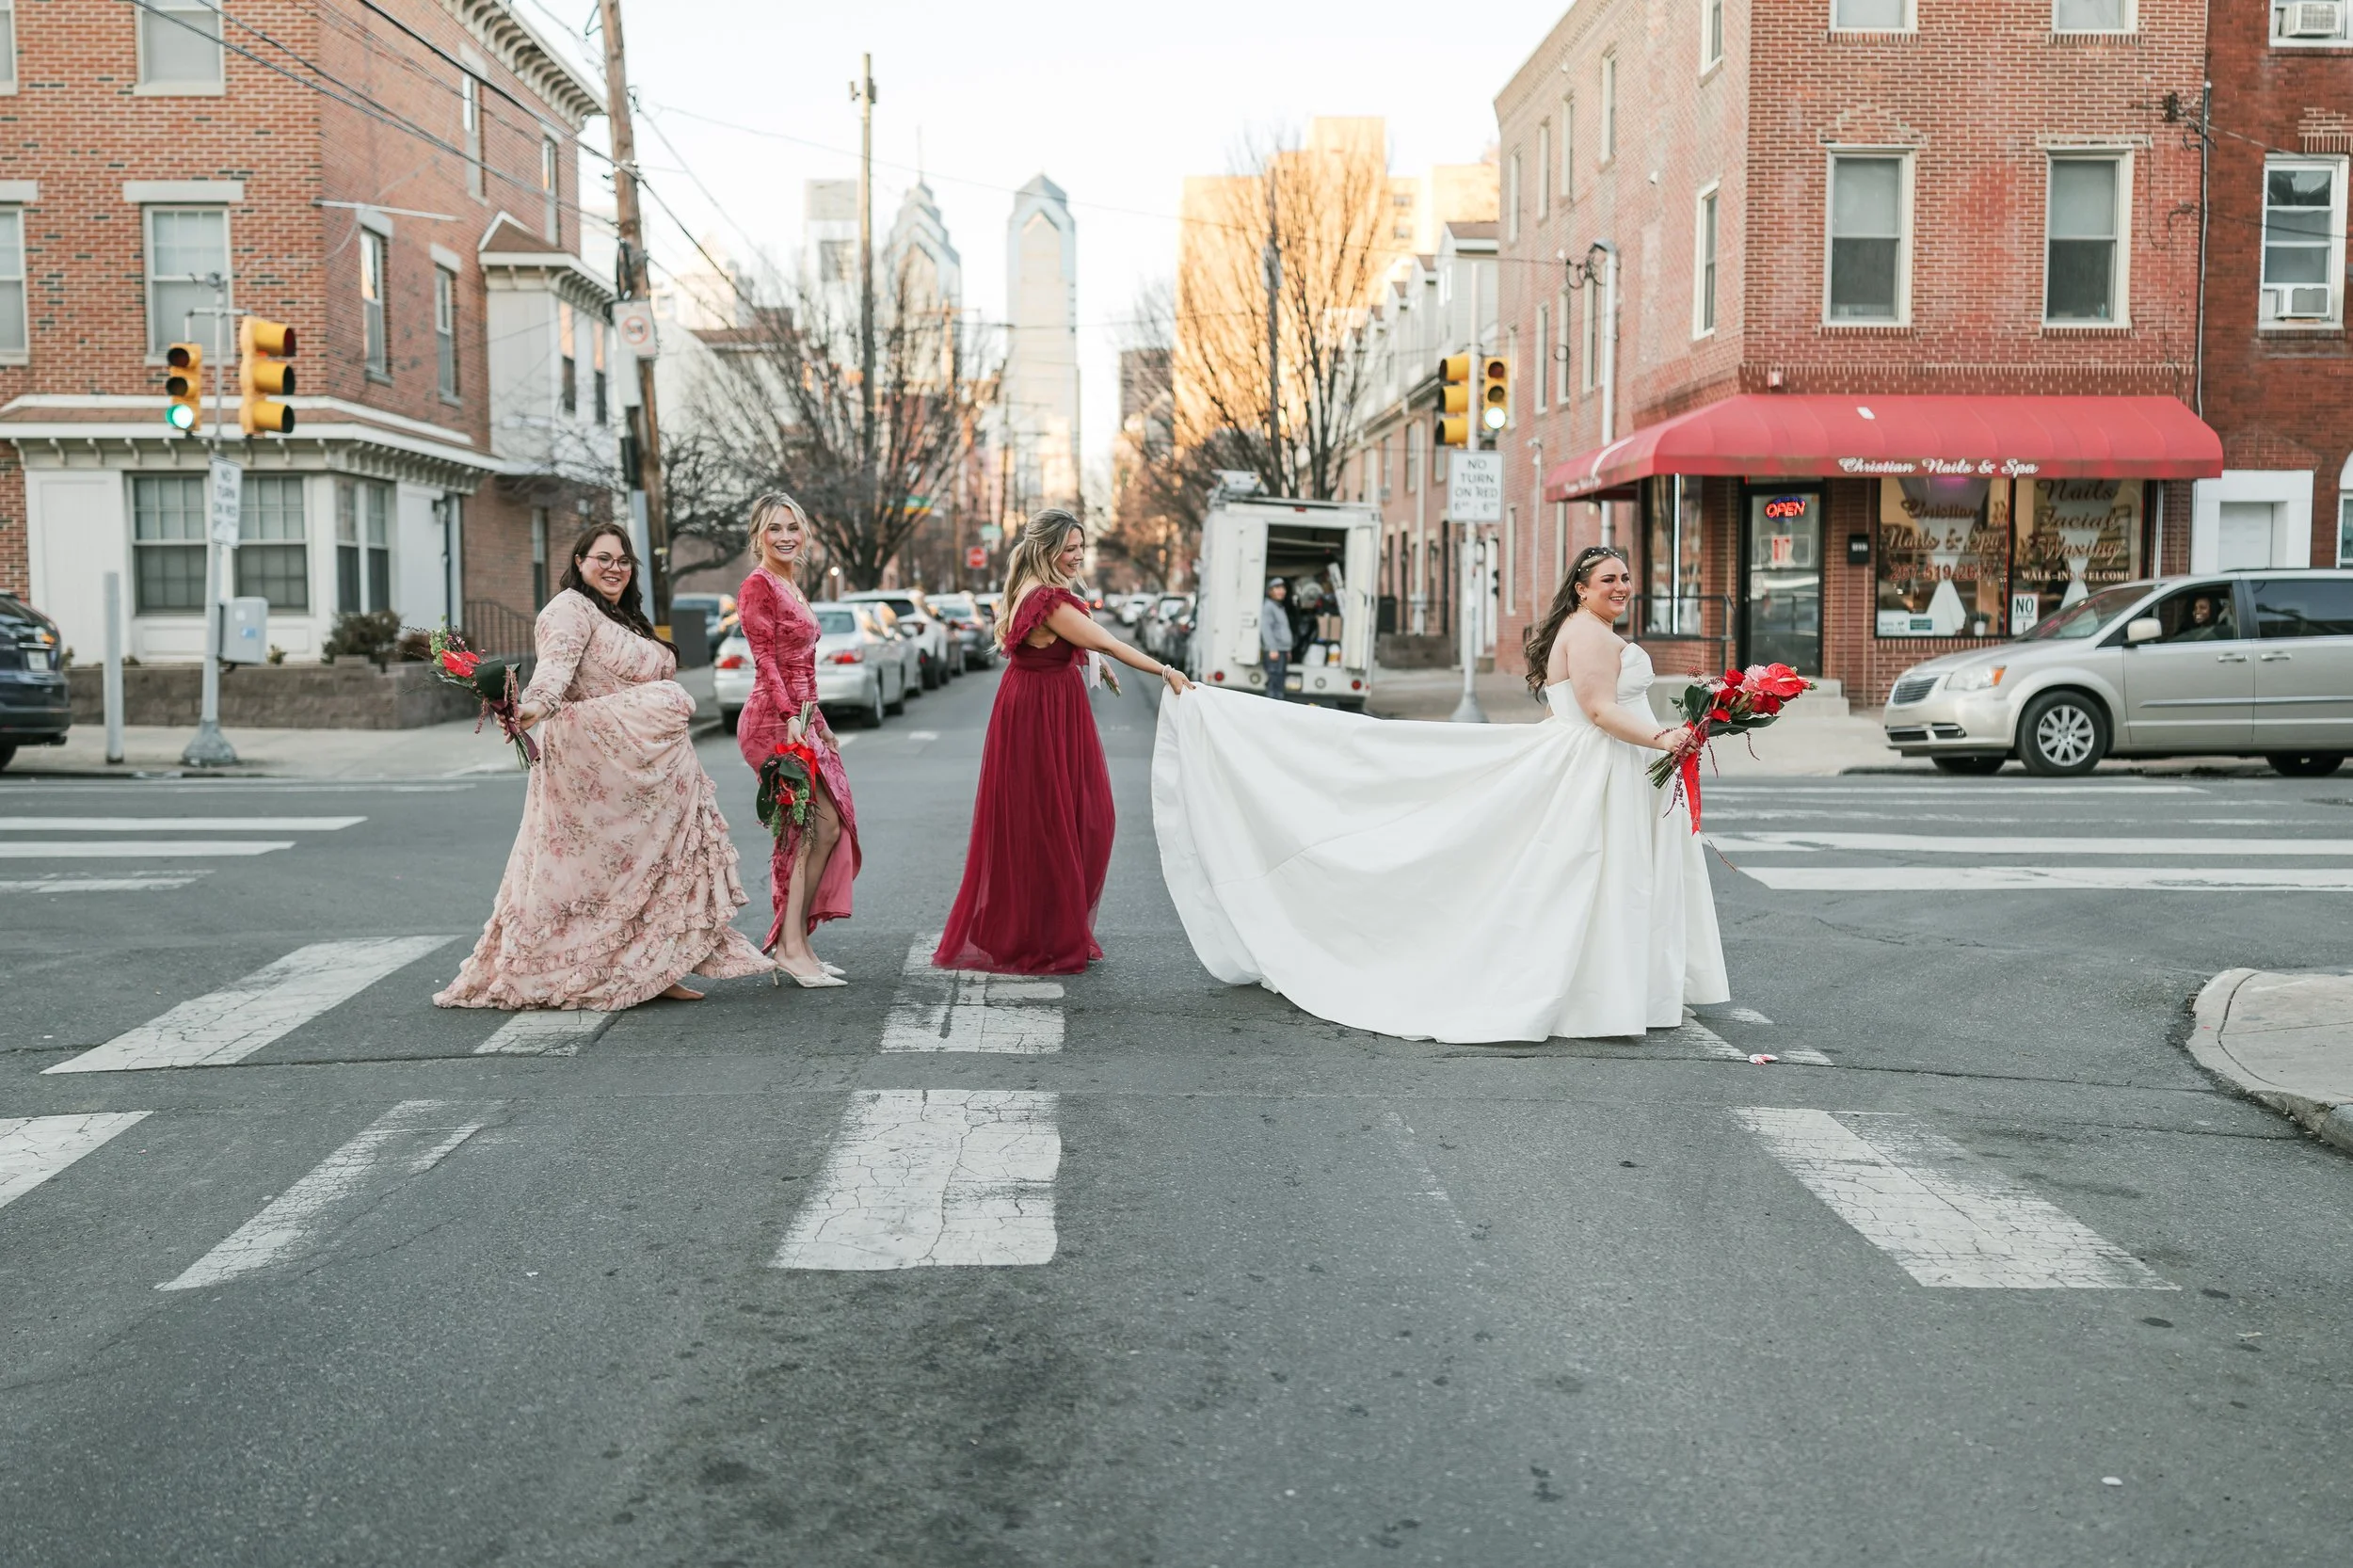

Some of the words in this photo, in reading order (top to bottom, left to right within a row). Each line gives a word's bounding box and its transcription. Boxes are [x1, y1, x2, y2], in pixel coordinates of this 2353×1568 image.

[1467, 458, 1487, 470] NO
[1837, 457, 1915, 473] Christian
[1922, 457, 1975, 474] Nails
[1978, 458, 1996, 474] &
[2001, 457, 2039, 478] Spa
[1461, 472, 1495, 485] TURN
[1454, 487, 1472, 498] ON
[1476, 487, 1498, 498] RED
[2036, 478, 2118, 502] Nails
[1765, 501, 1806, 519] OPEN
[1883, 526, 1941, 551] Nails
[1945, 528, 1962, 551] &
[1965, 523, 2007, 557] Spa
[2037, 534, 2125, 566] Waxing
[2078, 569, 2131, 582] WELCOME
[2016, 598, 2035, 616] NO
